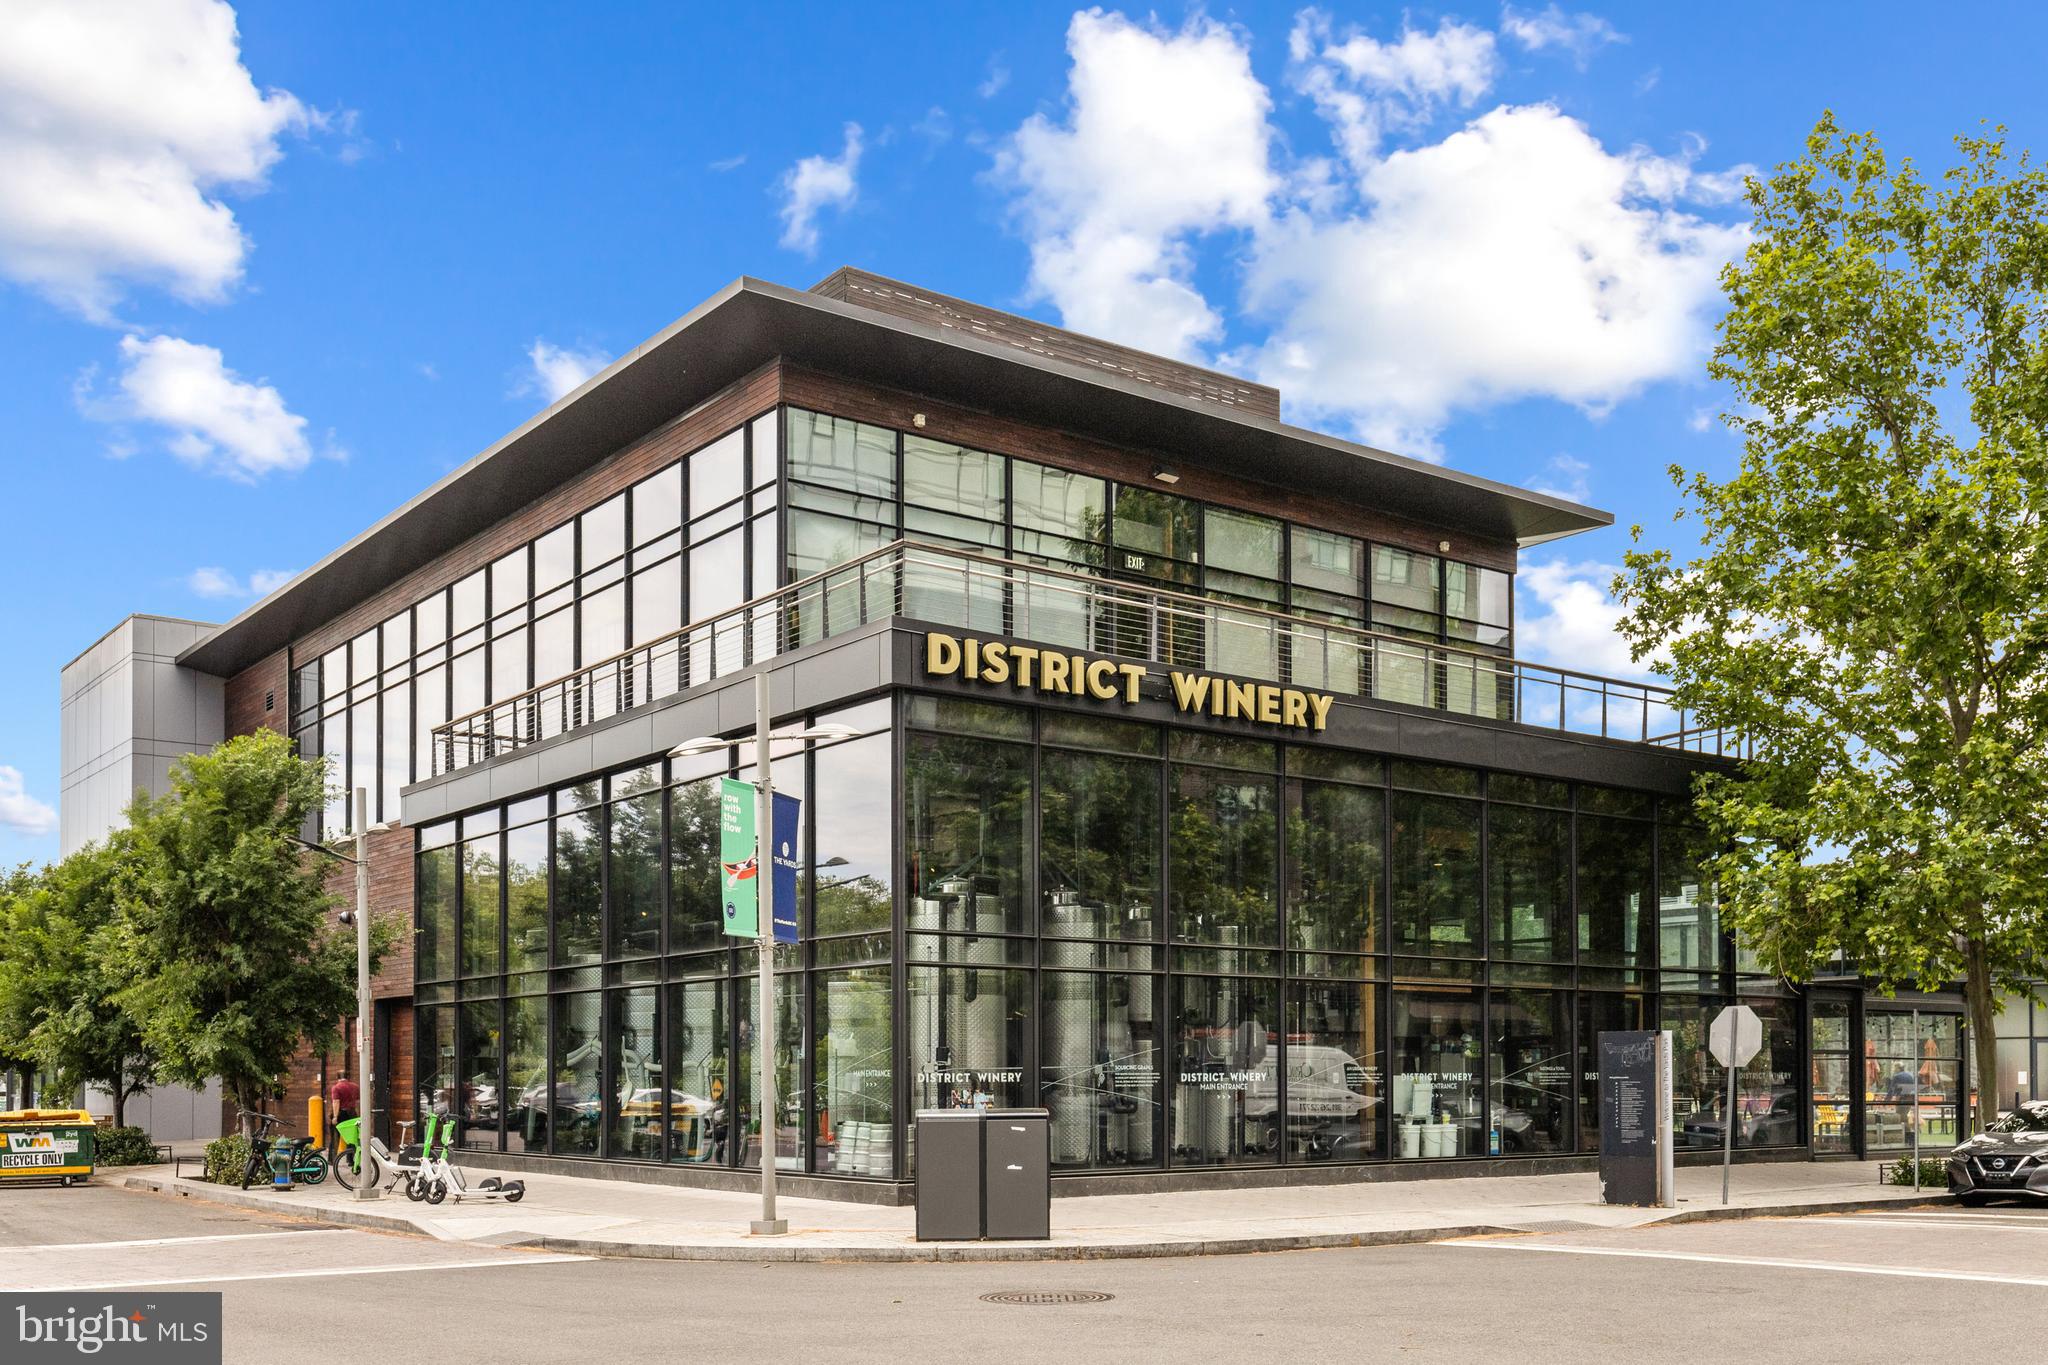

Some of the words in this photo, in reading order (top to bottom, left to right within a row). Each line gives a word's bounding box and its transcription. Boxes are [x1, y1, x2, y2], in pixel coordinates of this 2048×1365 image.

[1127, 555, 1143, 570] EXIT
[927, 632, 1147, 704] DISTRICT
[1170, 671, 1334, 731] WINERY
[724, 794, 739, 803] row
[723, 804, 741, 814] with
[723, 813, 737, 823] the
[723, 822, 742, 833] flow
[774, 856, 783, 864] THE
[783, 859, 797, 869] YARDS
[865, 1069, 891, 1078] ENTRANCE
[917, 1072, 971, 1083] DISTRICT
[977, 1072, 1022, 1083] WINERY
[1180, 1072, 1225, 1082] DISTRICT
[1230, 1072, 1267, 1082] WINERY
[1400, 1072, 1438, 1081] DISTRICT
[1442, 1072, 1473, 1081] WINERY
[1739, 1072, 1765, 1080] DISTRICT
[1766, 1072, 1792, 1080] WINERY
[1200, 1083, 1216, 1091] MAIN
[1216, 1083, 1248, 1091] ENTRANCE
[1430, 1082, 1458, 1090] ENTRANCE
[14, 1137, 52, 1148] WM
[3, 1154, 40, 1167] RECYCLE
[42, 1153, 63, 1165] ONLY
